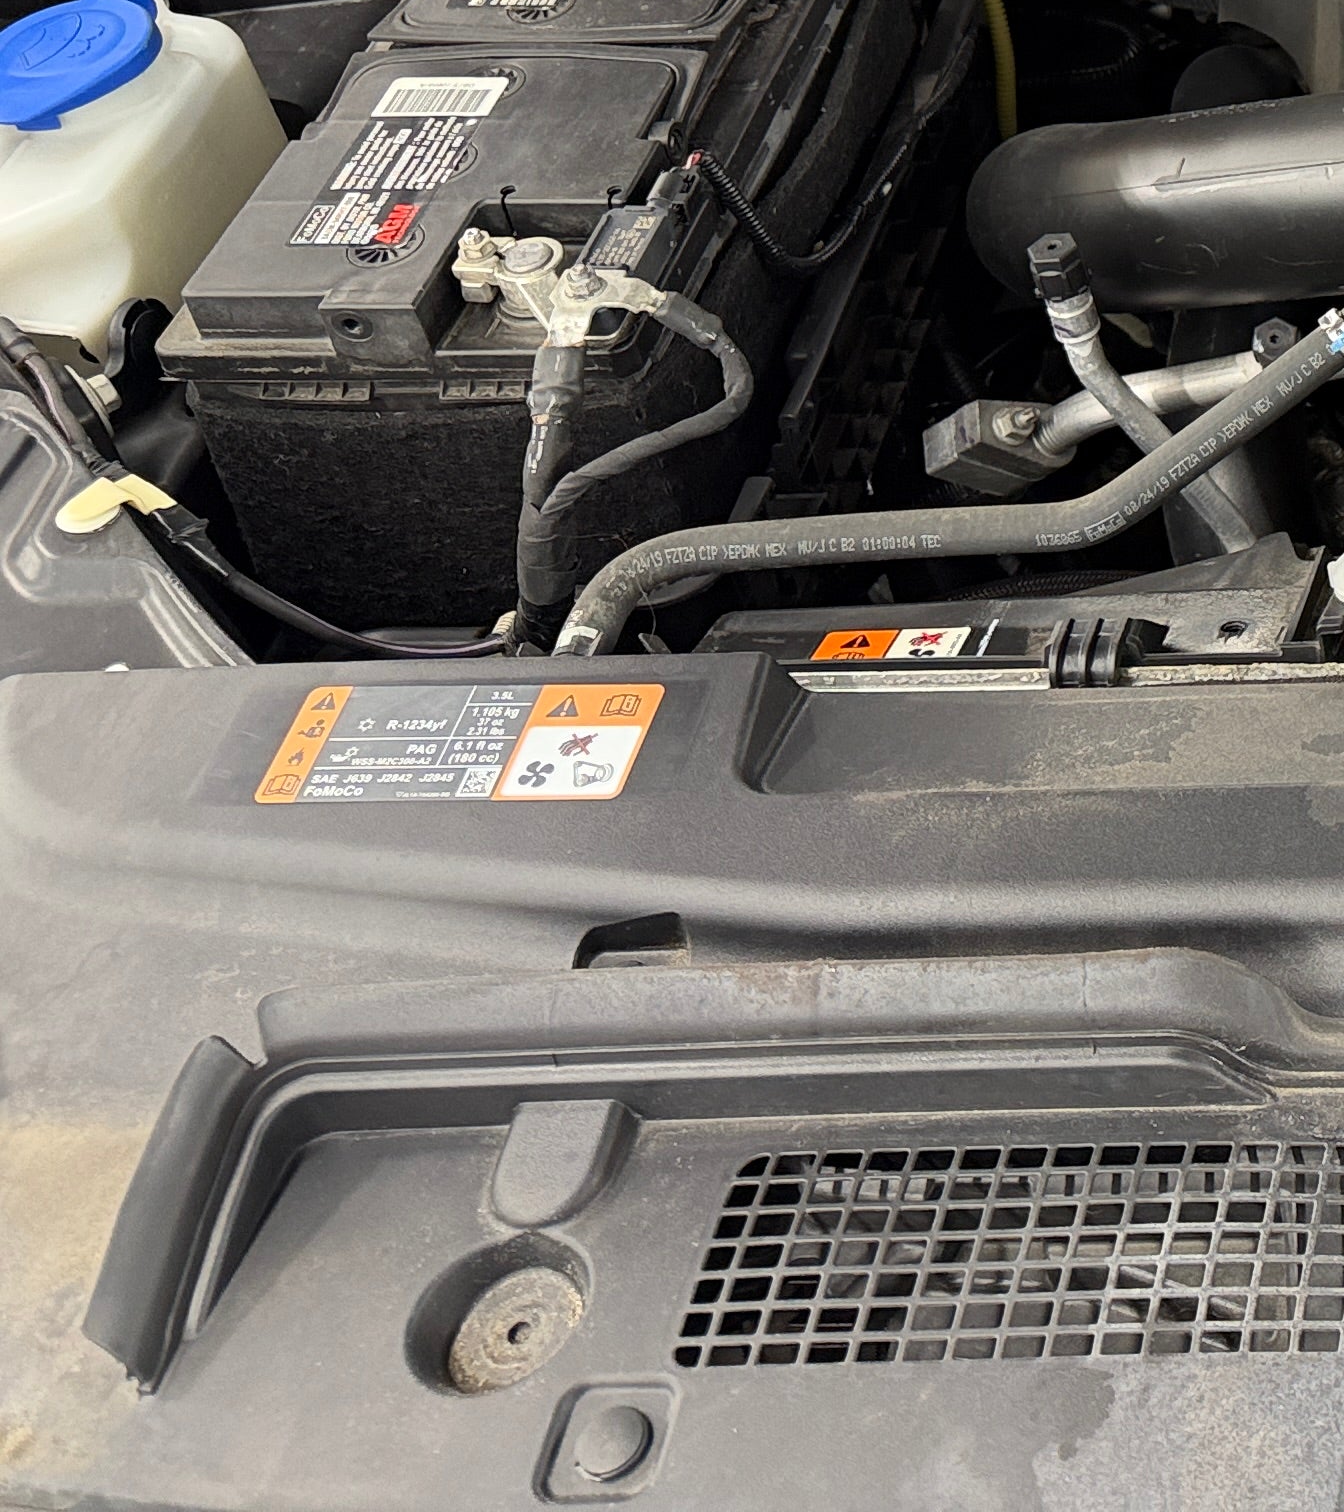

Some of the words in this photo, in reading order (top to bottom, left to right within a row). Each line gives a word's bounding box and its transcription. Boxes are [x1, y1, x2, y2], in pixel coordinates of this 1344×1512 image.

[374, 204, 414, 244] AGM
[1124, 476, 1170, 516] 08/24/19
[1200, 438, 1218, 458] CIP
[1301, 363, 1312, 377] C
[1308, 352, 1326, 369] B2
[698, 544, 718, 561] CIP
[828, 538, 838, 552] C
[841, 537, 856, 552] B2
[920, 534, 942, 548] TEC
[491, 691, 514, 701] 3.5L
[472, 706, 503, 717] 1.105
[504, 706, 520, 719] kg
[386, 719, 448, 732] R-1234yf
[477, 717, 491, 726] 37
[491, 718, 504, 726] oz
[466, 726, 488, 736] 2.31
[406, 743, 437, 755] PAG
[453, 740, 473, 751] 6.1
[476, 740, 487, 751] fl
[487, 742, 505, 751] oz
[447, 752, 477, 765] (180
[478, 752, 500, 765] cc)
[310, 774, 339, 784] SAE
[343, 774, 373, 784] J639
[377, 773, 414, 784] J2842
[418, 773, 455, 784] J2845
[303, 785, 364, 797] FoMoCo
